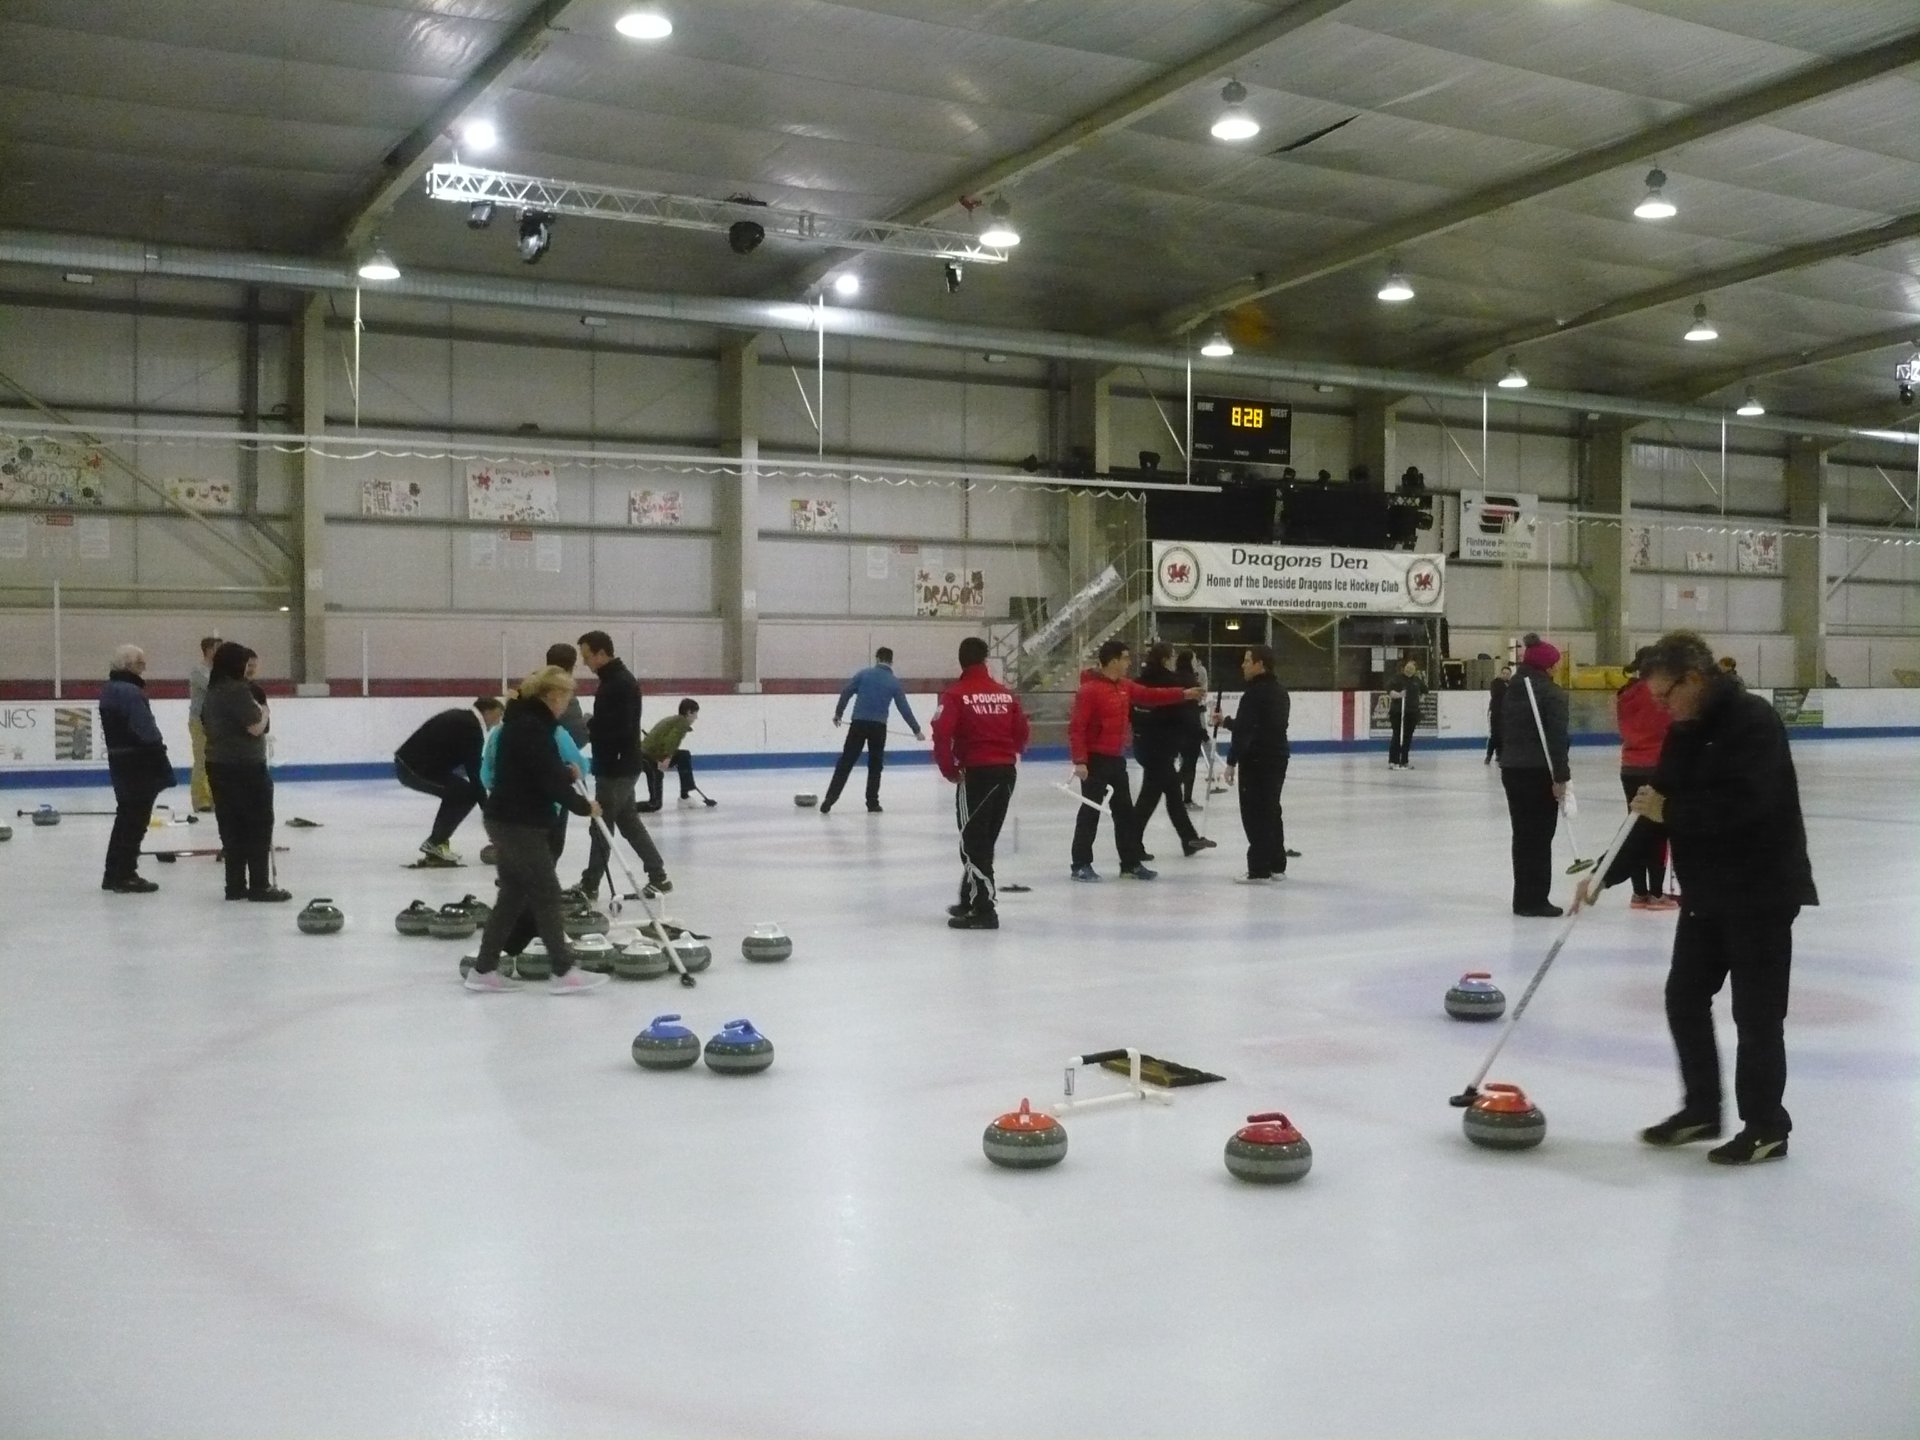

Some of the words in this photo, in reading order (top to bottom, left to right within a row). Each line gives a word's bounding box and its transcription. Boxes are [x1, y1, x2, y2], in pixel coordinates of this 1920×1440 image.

[1231, 548, 1322, 571] Dragons
[1330, 552, 1369, 569] Den
[1470, 548, 1481, 557] Ice
[1206, 573, 1231, 587] Home
[1234, 575, 1243, 588] of
[1246, 575, 1259, 588] the
[1262, 576, 1296, 589] Deeside
[1298, 577, 1332, 592] Dragons
[1335, 578, 1347, 591] Ice
[1350, 579, 1378, 594] Hockey
[1381, 580, 1399, 593] Club
[923, 585, 983, 605] DRAGONS
[1240, 597, 1367, 609] www.deesidedragons.com
[972, 704, 1008, 714] WALES
